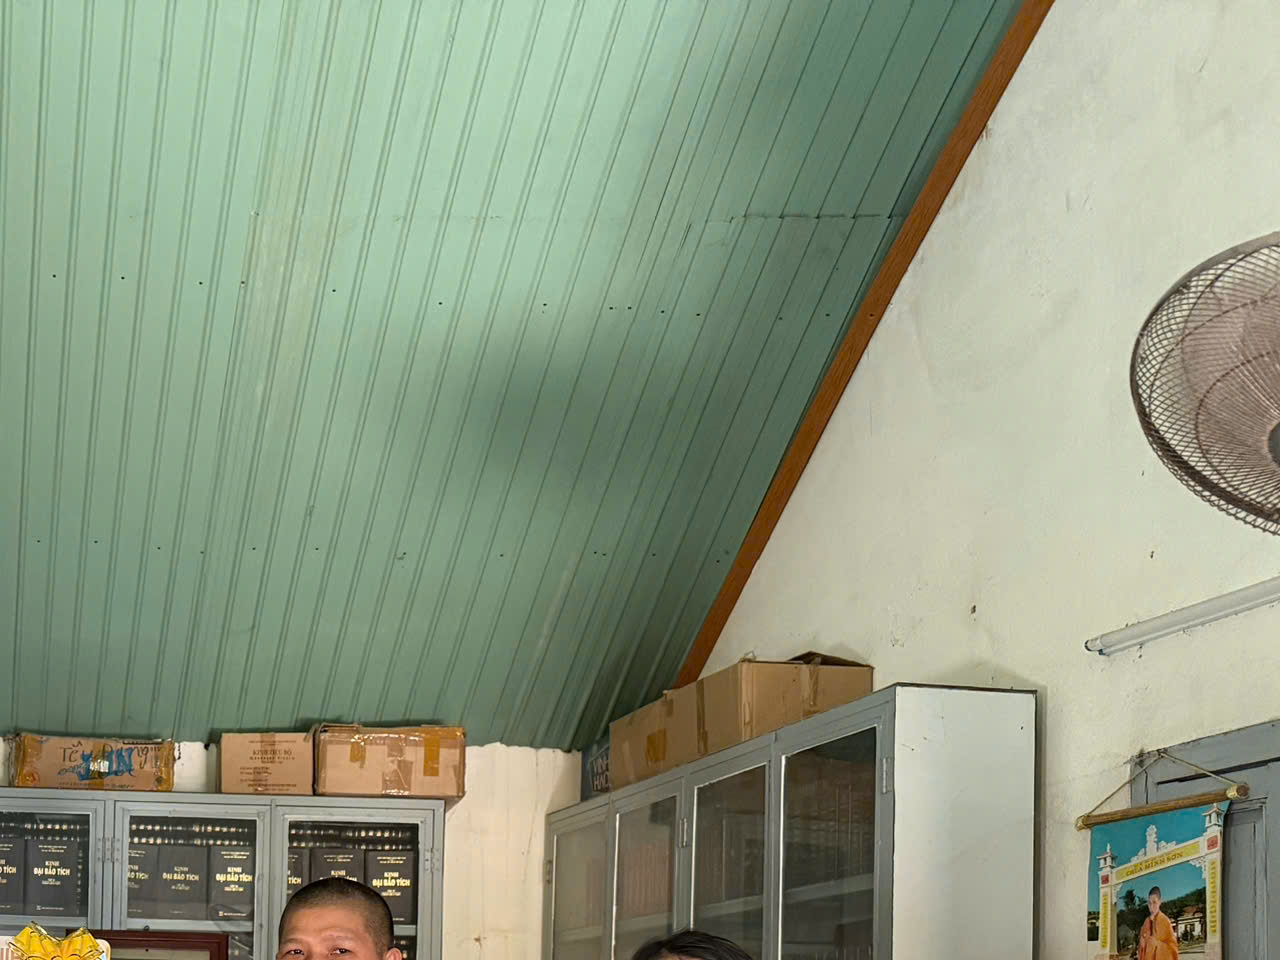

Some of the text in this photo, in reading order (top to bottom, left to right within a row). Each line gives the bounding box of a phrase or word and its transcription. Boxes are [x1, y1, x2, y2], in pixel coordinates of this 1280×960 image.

[3, 865, 17, 874] TÍCH
[57, 866, 71, 876] TÍCH
[240, 873, 253, 882] TÍCH
[396, 877, 411, 887] TÍCH
